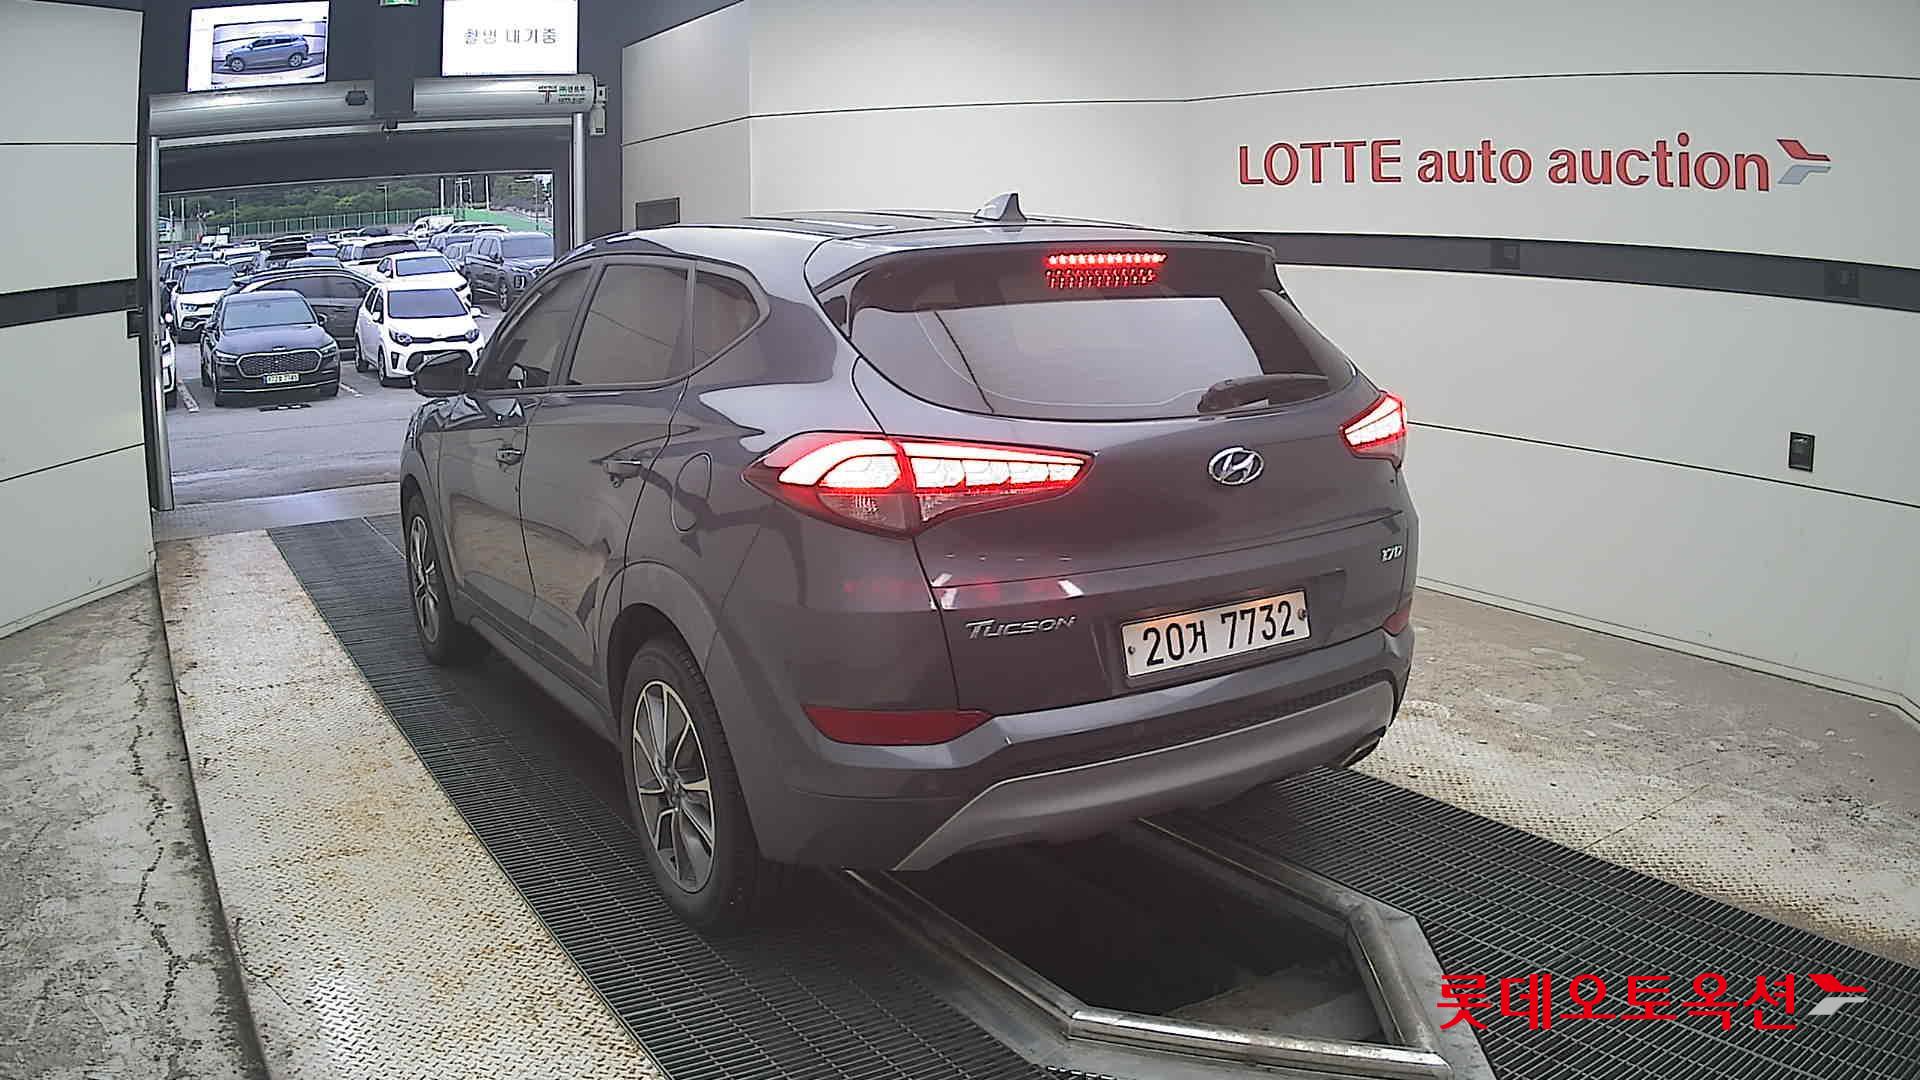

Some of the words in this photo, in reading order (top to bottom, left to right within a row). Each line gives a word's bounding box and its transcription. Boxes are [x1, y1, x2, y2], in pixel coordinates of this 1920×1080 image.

[1239, 139, 1401, 185] LOTTE
[1417, 141, 1532, 184] auto
[1548, 131, 1770, 190] auction
[1143, 619, 1207, 666] 20거
[1220, 601, 1295, 649] 7732
